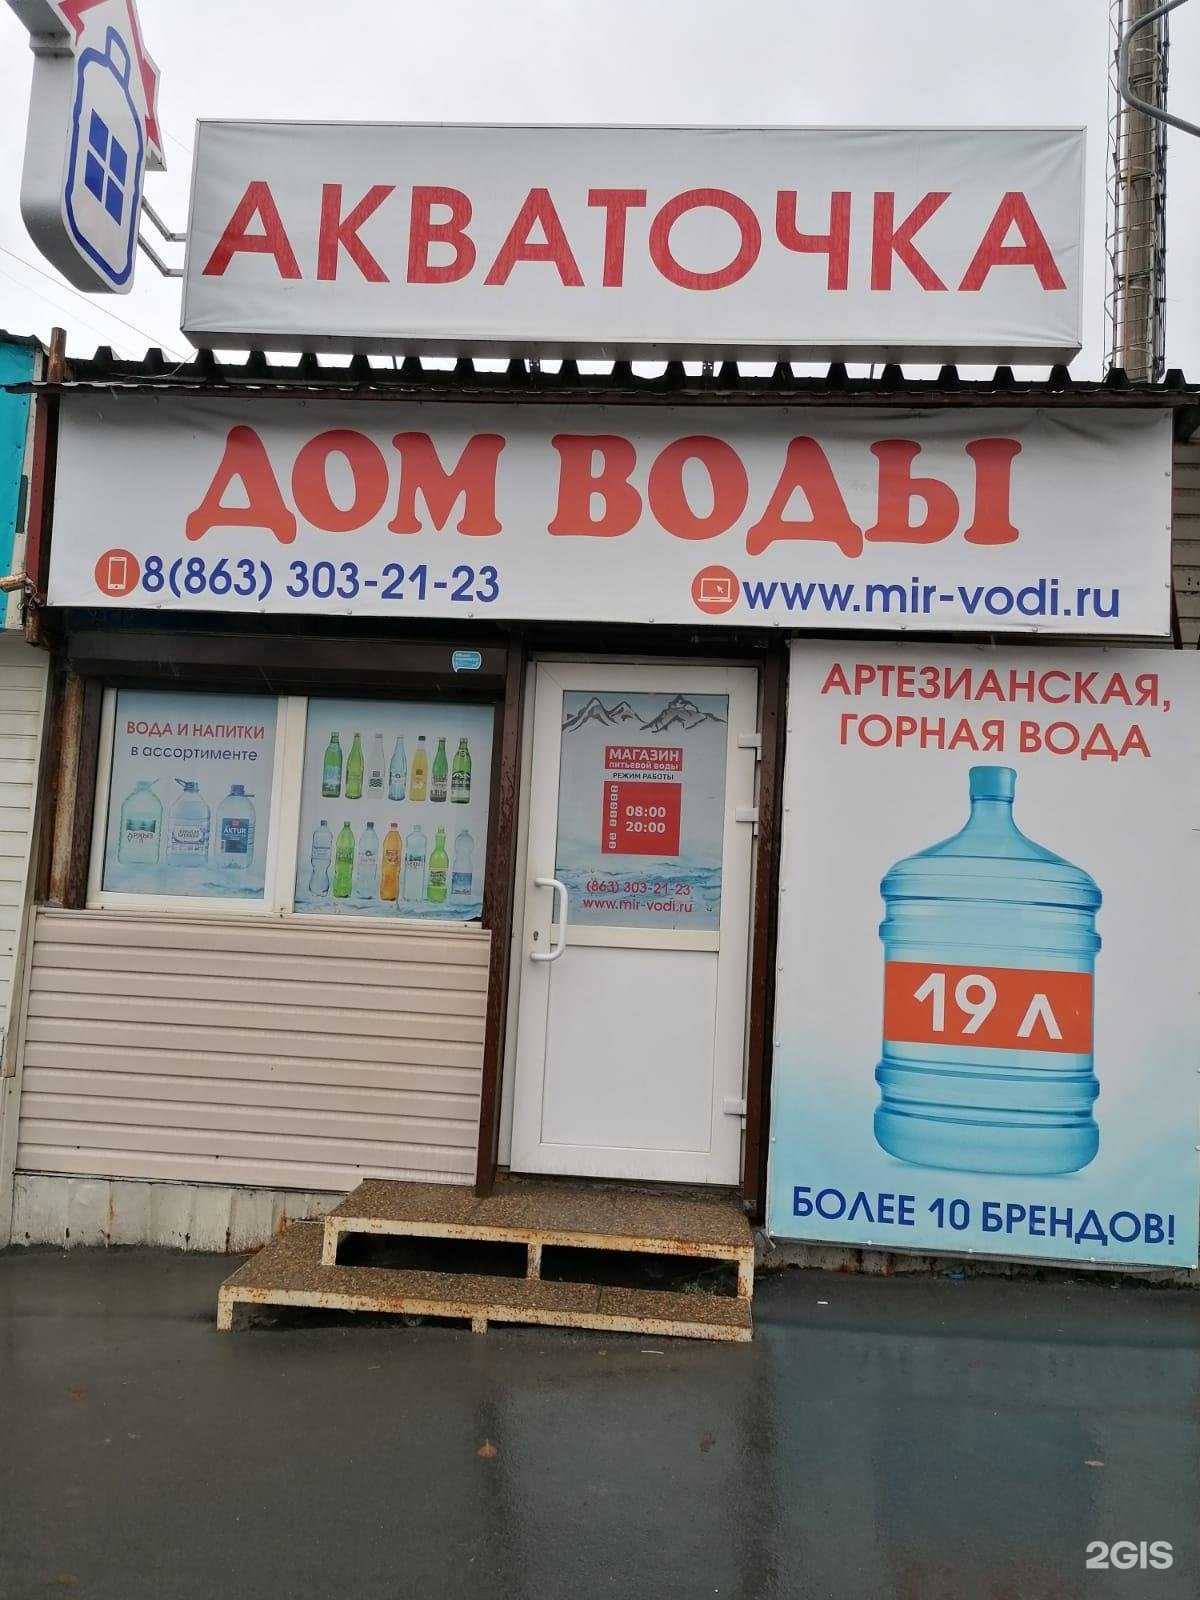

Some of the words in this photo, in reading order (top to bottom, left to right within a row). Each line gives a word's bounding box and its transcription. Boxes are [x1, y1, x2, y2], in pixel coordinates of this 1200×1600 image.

[203, 181, 1066, 292] АКВАТОЧКА
[185, 426, 506, 545] ДОМ
[547, 434, 1021, 559] ВОДЫ
[142, 556, 273, 602] 8(863)
[287, 561, 501, 603] 303-21-23
[742, 577, 1120, 618] www.mir-vodi.ru
[821, 663, 1171, 712] АРТЕЗИАНСКАЯ,
[127, 721, 173, 737] ВОДА
[177, 724, 189, 736] И
[193, 725, 265, 740] НАПИТКИ
[839, 712, 1005, 753] ГОРНАЯ
[1019, 720, 1152, 762] ВОДА
[142, 746, 258, 762] ассортименте
[609, 748, 680, 762] МАГАЗИН
[613, 772, 641, 780] РЕЖИМ
[643, 773, 674, 781] РАБОТЫ
[626, 806, 667, 818] 08:00
[625, 821, 667, 834] 20:00
[586, 881, 619, 893] (863)
[623, 882, 690, 895] 303-21-23
[583, 899, 692, 912] www.mir-vodi.ru
[913, 972, 997, 1034] 19
[792, 1185, 915, 1226] БОЛЕЕ
[927, 1198, 970, 1230] 10
[981, 1201, 1175, 1246] БРЕНДОВ!
